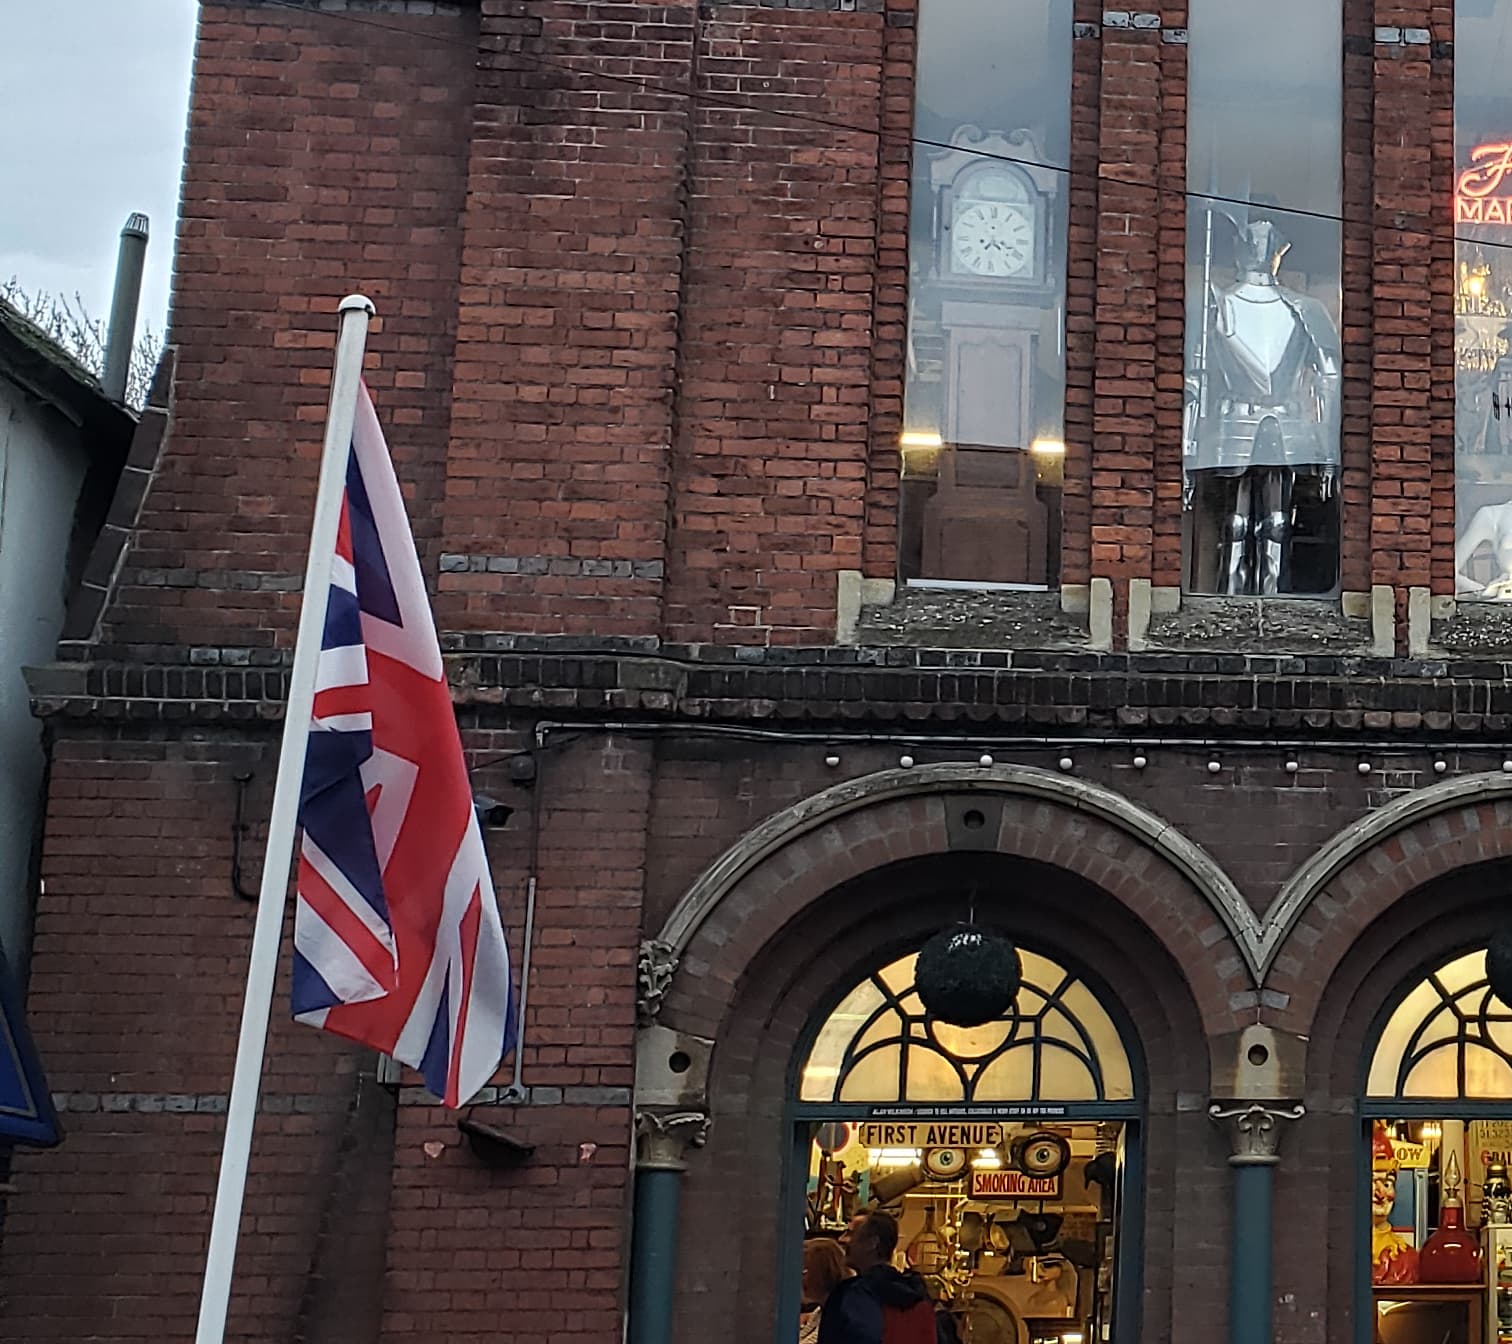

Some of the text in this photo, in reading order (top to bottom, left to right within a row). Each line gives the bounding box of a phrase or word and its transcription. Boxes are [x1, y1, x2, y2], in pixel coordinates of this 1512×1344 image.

[866, 1125, 997, 1145] FIRST AVENUE
[1396, 1147, 1424, 1161] OW
[975, 1173, 1056, 1193] SMOKING AREA
